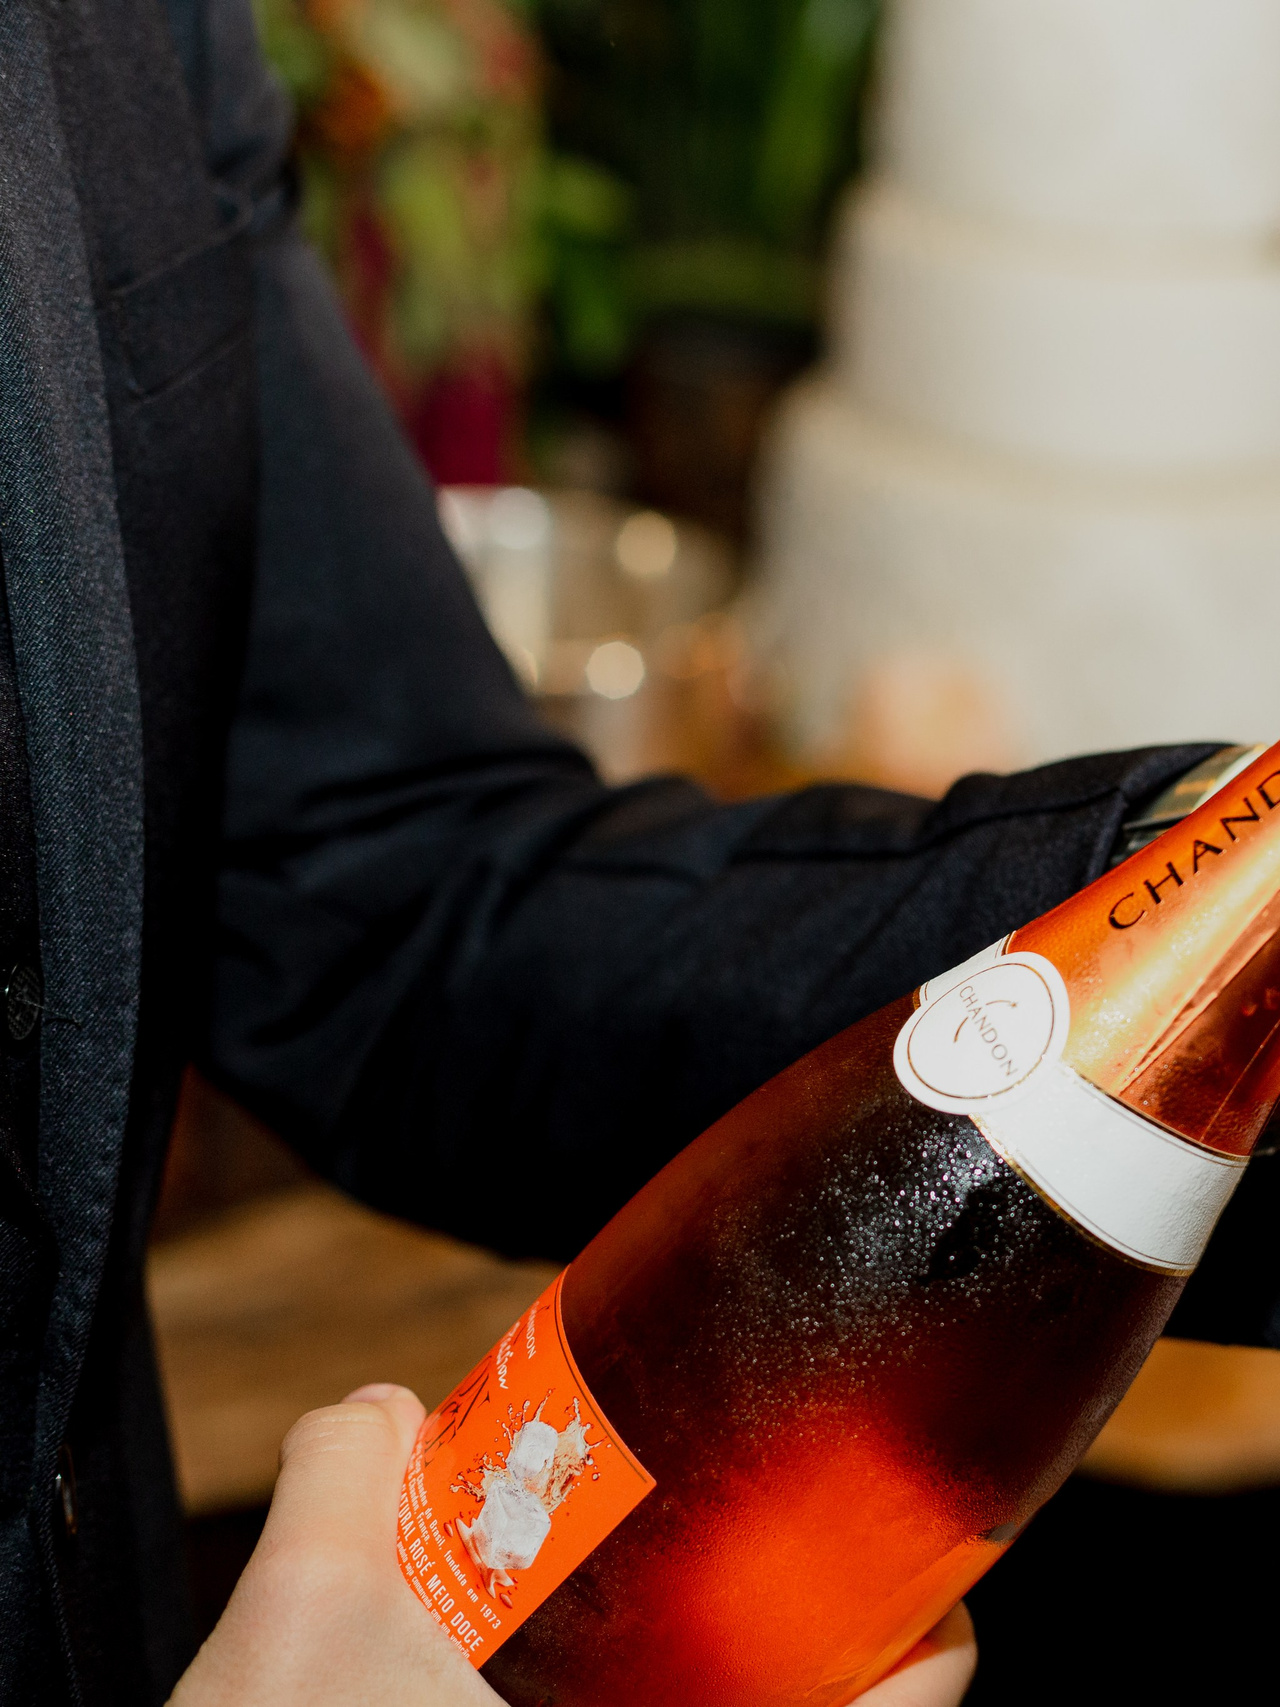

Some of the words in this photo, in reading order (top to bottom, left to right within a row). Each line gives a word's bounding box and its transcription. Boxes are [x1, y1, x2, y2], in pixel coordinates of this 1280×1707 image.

[959, 985, 1018, 1076] CHANDON
[416, 1511, 430, 1545] França.
[408, 1537, 436, 1577] ROSÉ
[426, 1573, 455, 1614] MEIO
[449, 1611, 484, 1652] DOCE
[411, 1576, 433, 1609] conservado
[429, 1518, 445, 1551] Brasil,
[443, 1549, 468, 1588] fundada
[467, 1588, 479, 1603] em
[479, 1603, 502, 1630] 1973
